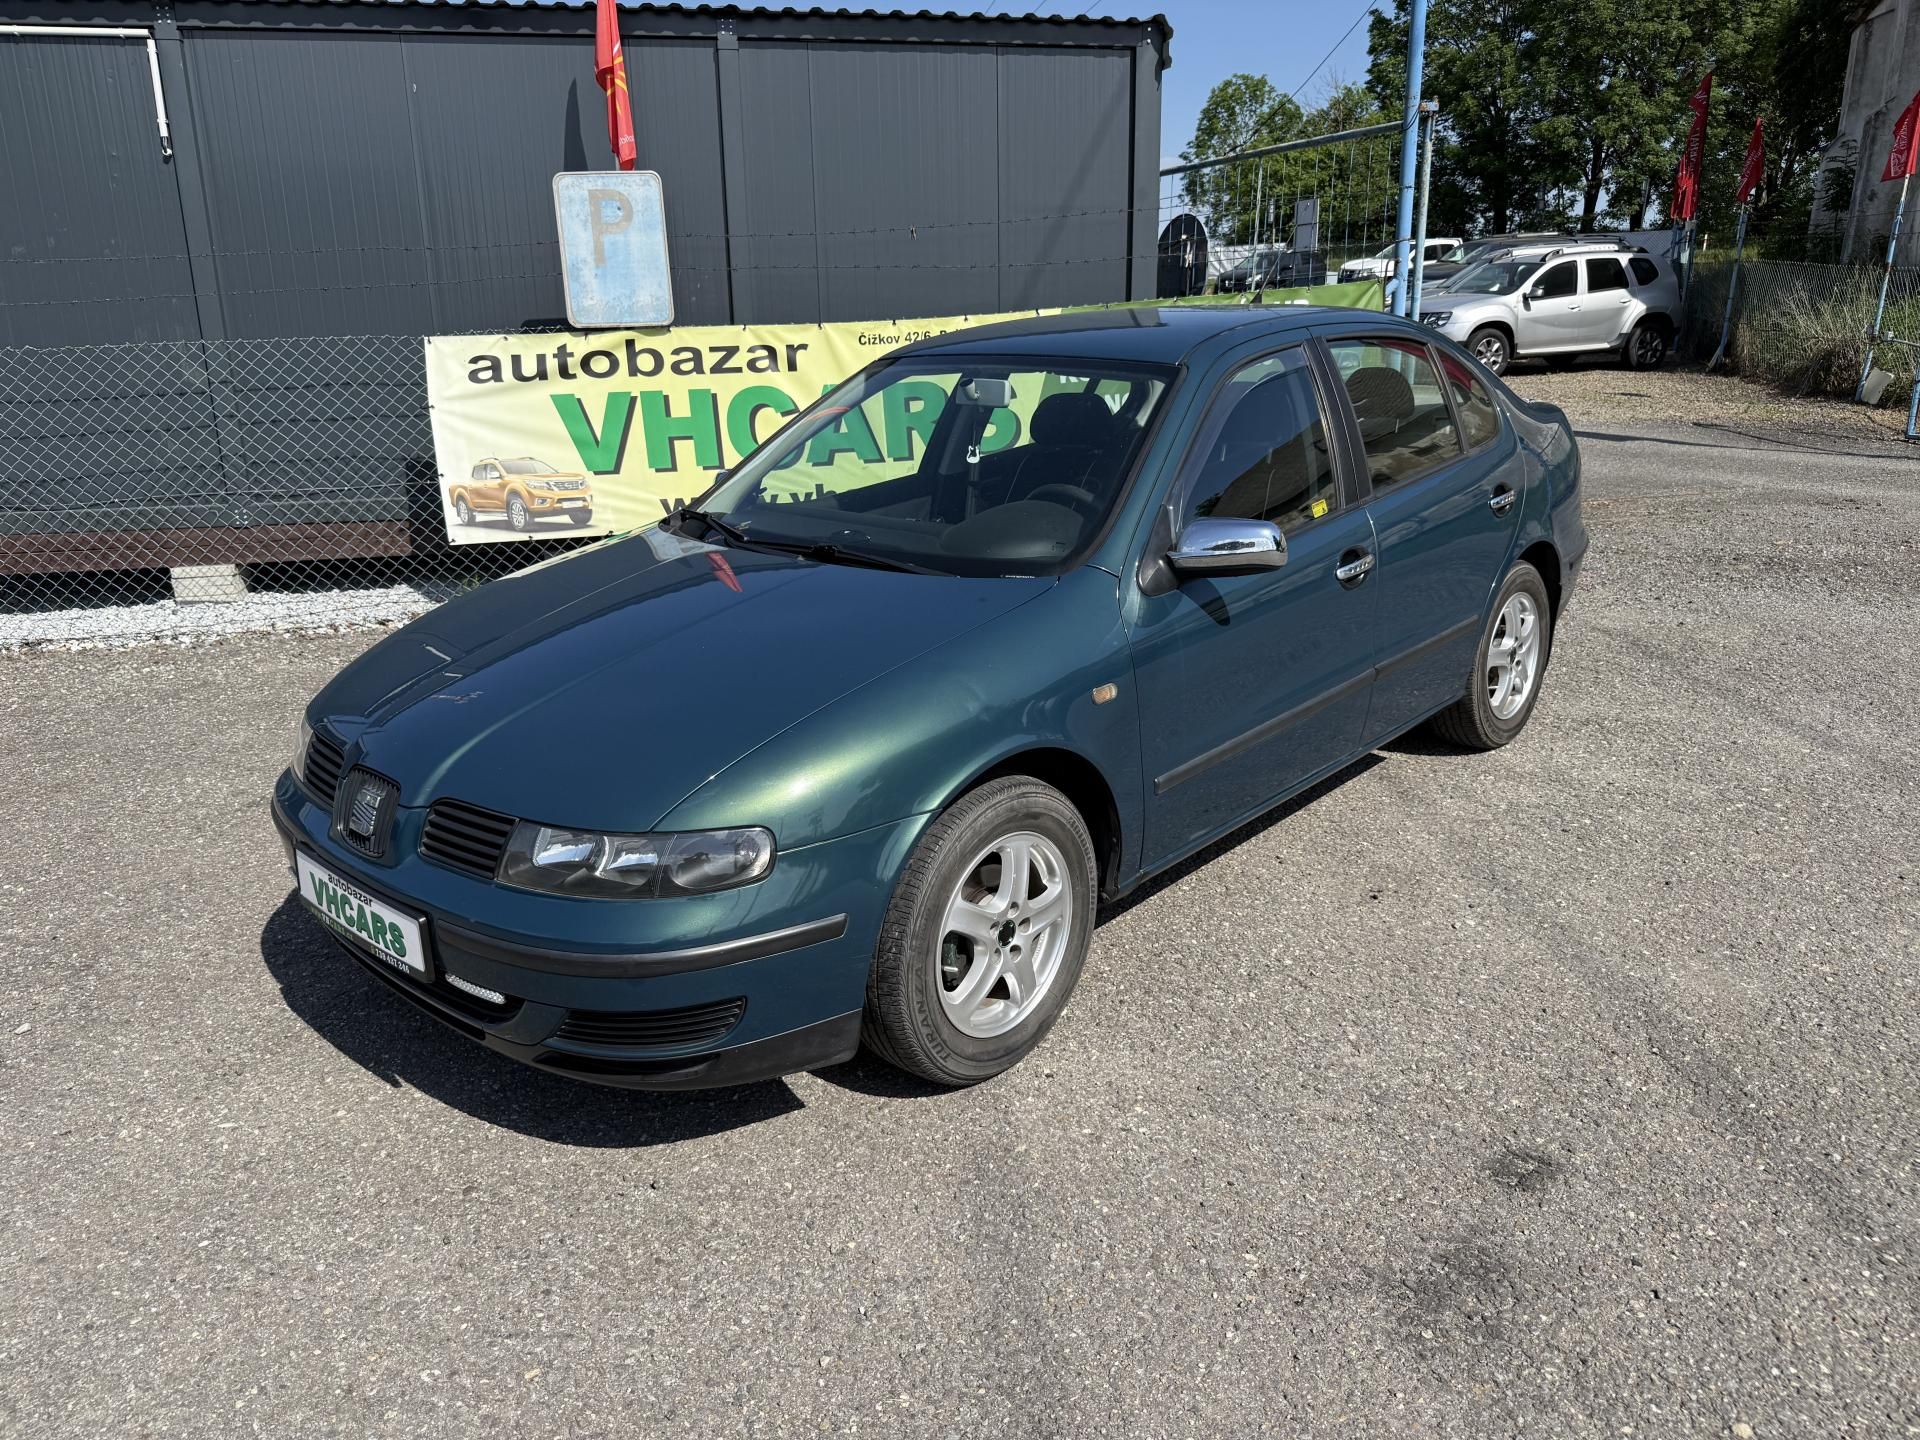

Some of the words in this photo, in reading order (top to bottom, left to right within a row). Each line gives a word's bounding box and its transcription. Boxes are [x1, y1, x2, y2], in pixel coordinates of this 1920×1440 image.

[588, 188, 634, 268] P
[467, 338, 809, 384] autobazar
[858, 331, 900, 346] Čížkov
[327, 873, 373, 907] autobazar
[309, 871, 407, 958] VHCARS
